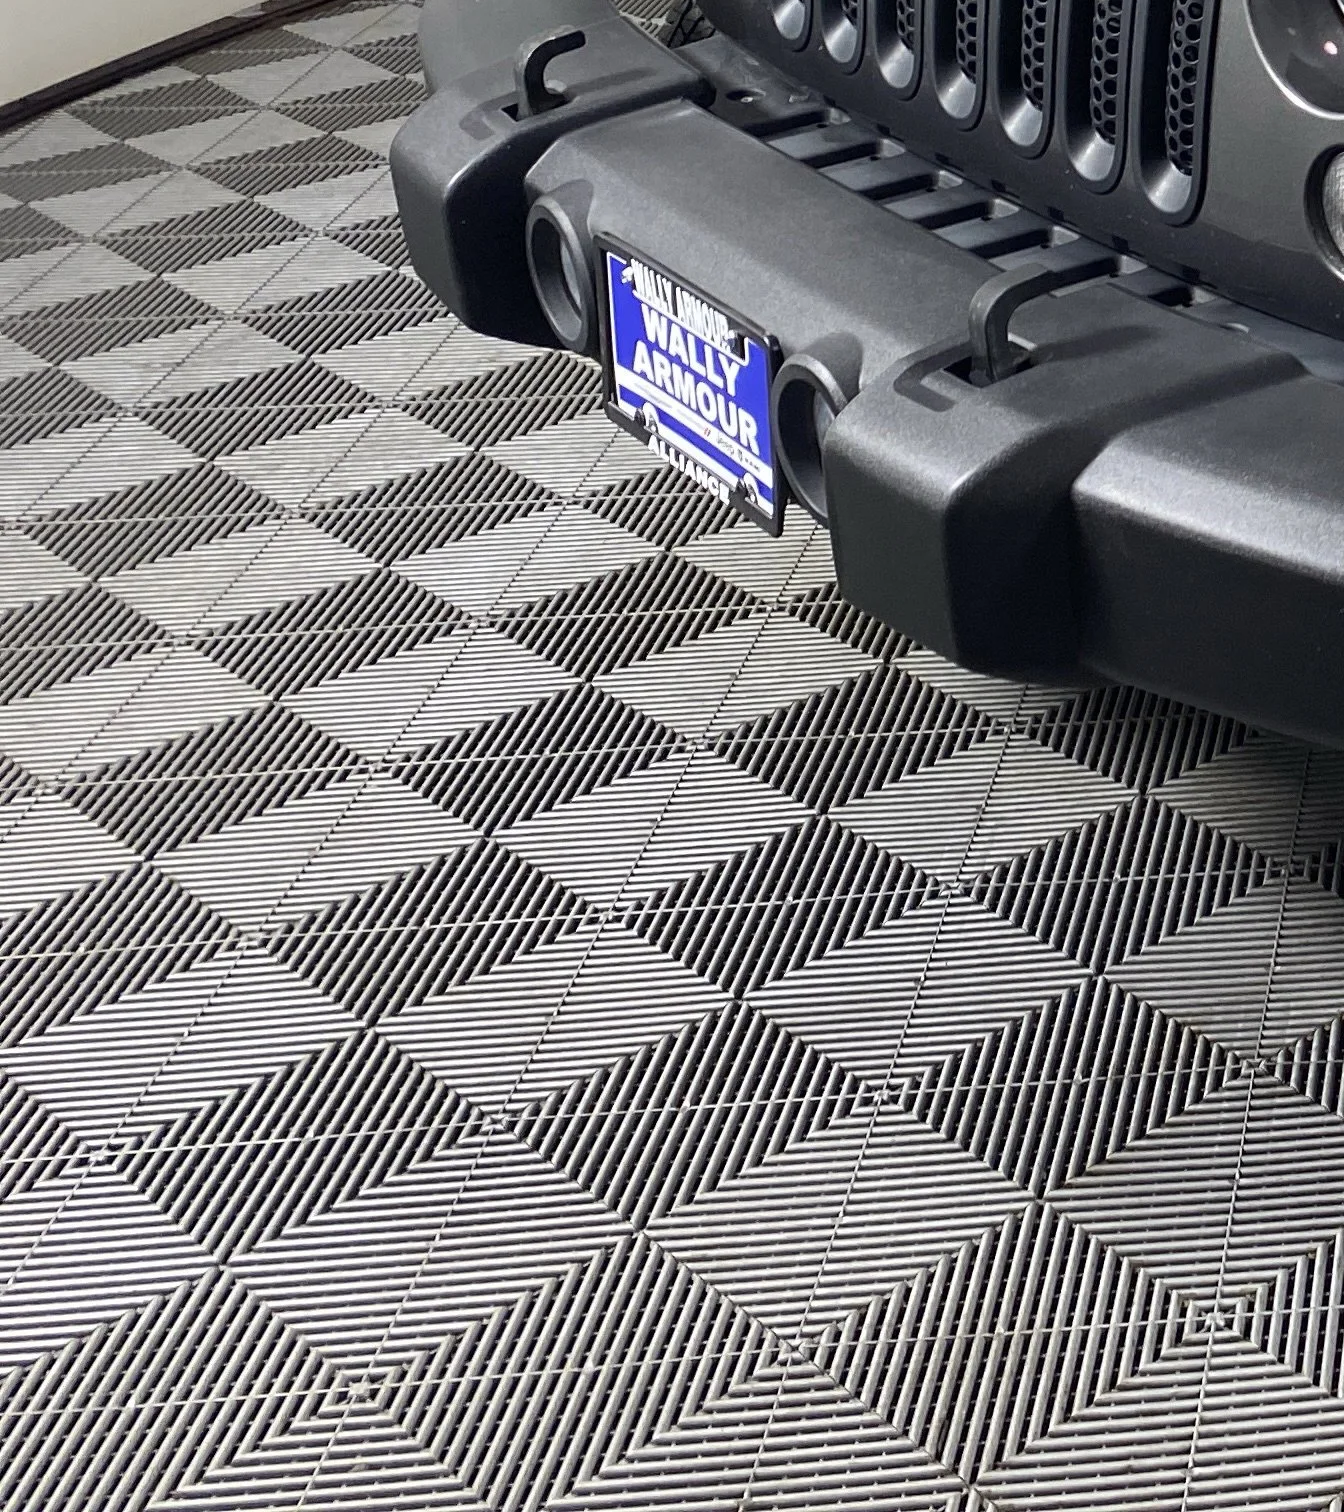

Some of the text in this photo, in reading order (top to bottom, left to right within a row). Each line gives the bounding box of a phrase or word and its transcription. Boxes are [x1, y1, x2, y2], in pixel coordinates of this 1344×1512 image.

[641, 303, 740, 397] WALLY
[633, 340, 760, 456] ARMOUR
[648, 434, 730, 506] ALLIANCE
